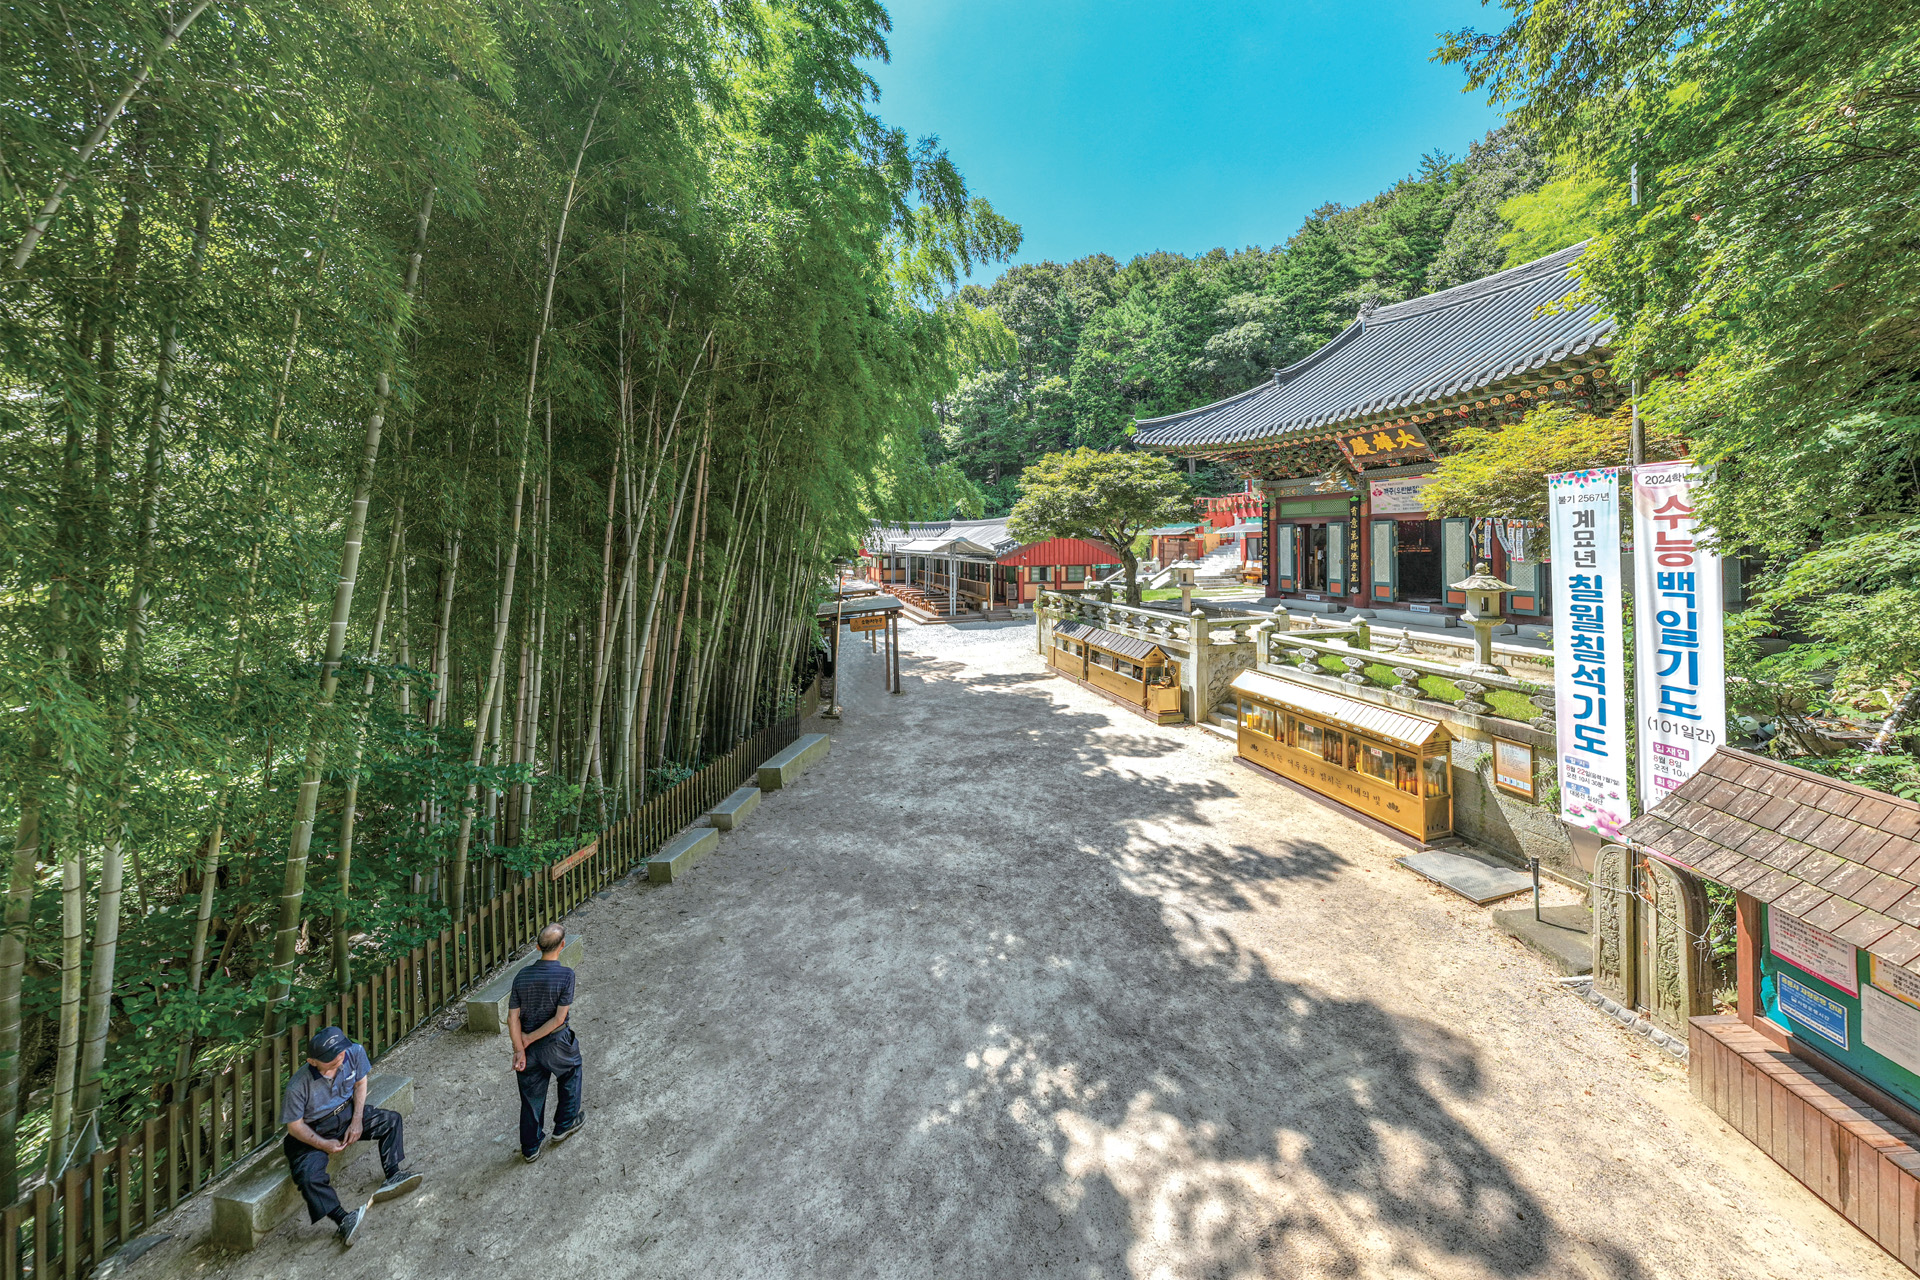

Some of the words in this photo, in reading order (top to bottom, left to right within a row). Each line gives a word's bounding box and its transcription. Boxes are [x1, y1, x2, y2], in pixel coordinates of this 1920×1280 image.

[1558, 495, 1575, 504] 불기
[1578, 492, 1610, 503] 2567년
[1572, 509, 1597, 568] 계묘년
[1653, 495, 1698, 567] 수능
[1656, 572, 1702, 720] 백일기도
[1568, 574, 1609, 757] 칠월칠석기도
[1648, 717, 1716, 745] (101일간)
[1653, 754, 1666, 764] 8월
[1668, 759, 1682, 769] 8일
[1655, 744, 1687, 759] 입재일
[1654, 763, 1669, 773] 오전
